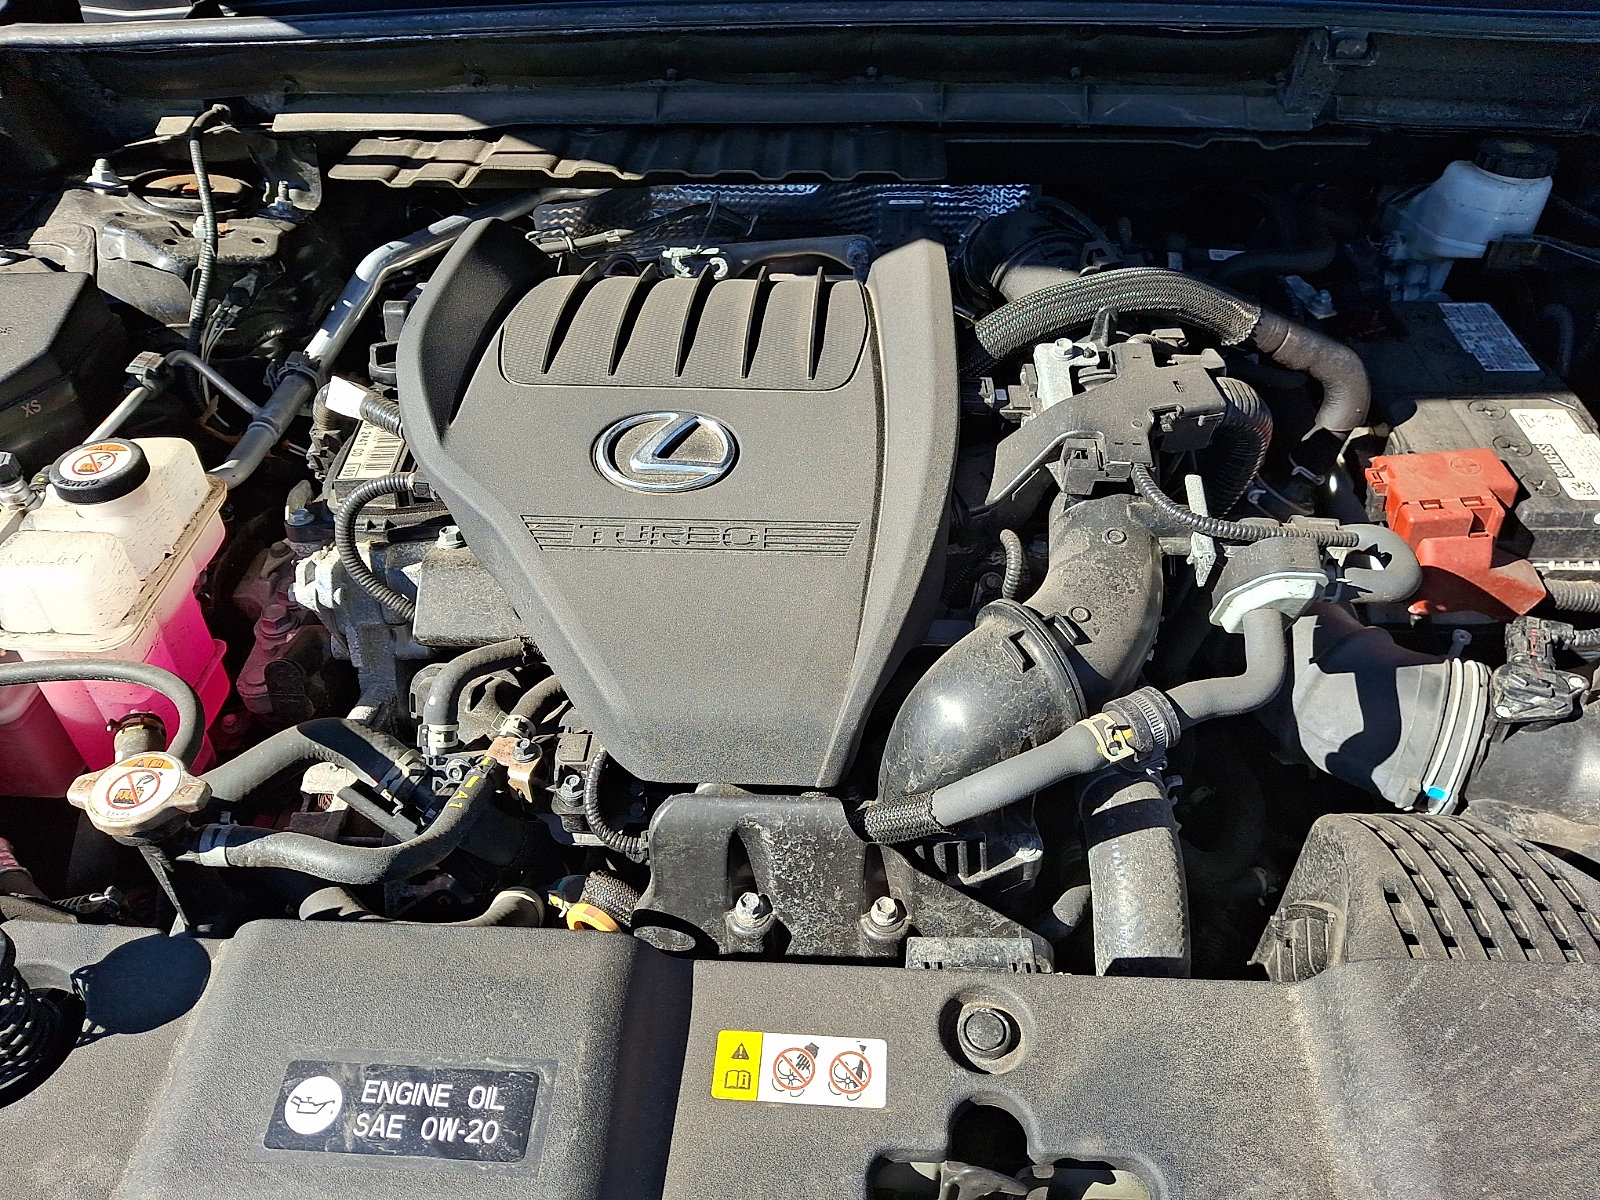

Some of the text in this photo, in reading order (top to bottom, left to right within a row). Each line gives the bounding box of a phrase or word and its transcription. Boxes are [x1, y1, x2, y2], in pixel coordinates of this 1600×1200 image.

[579, 523, 760, 548] TURBO
[360, 1079, 506, 1111] ENGINE OIL
[352, 1112, 501, 1144] SAE 0W-20
